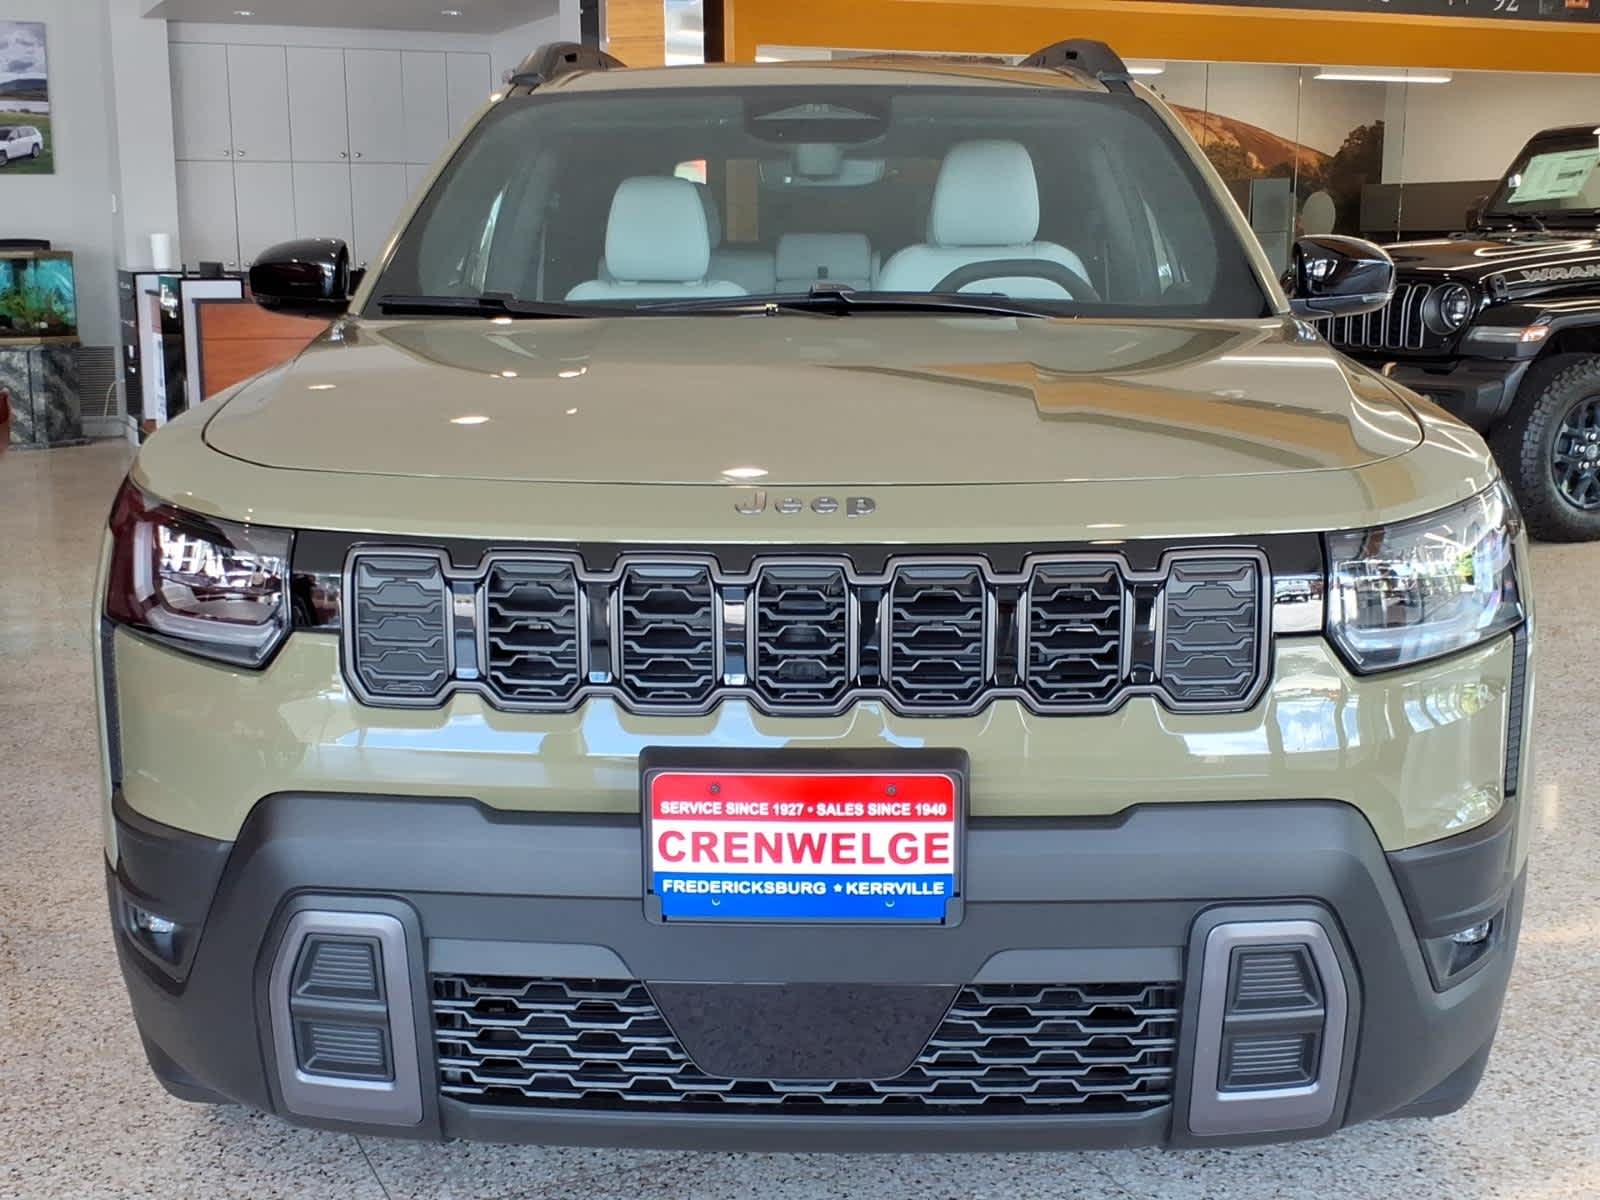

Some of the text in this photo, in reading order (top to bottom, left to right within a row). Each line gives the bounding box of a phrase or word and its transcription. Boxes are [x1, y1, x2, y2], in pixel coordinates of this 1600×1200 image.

[735, 490, 877, 518] Jeep
[660, 801, 947, 816] SERVICE SINCE 1927 SALES SINCE 1940
[657, 830, 950, 865] CRENWELGE
[662, 879, 945, 896] FREDERICKSBURG KERRVILLE
